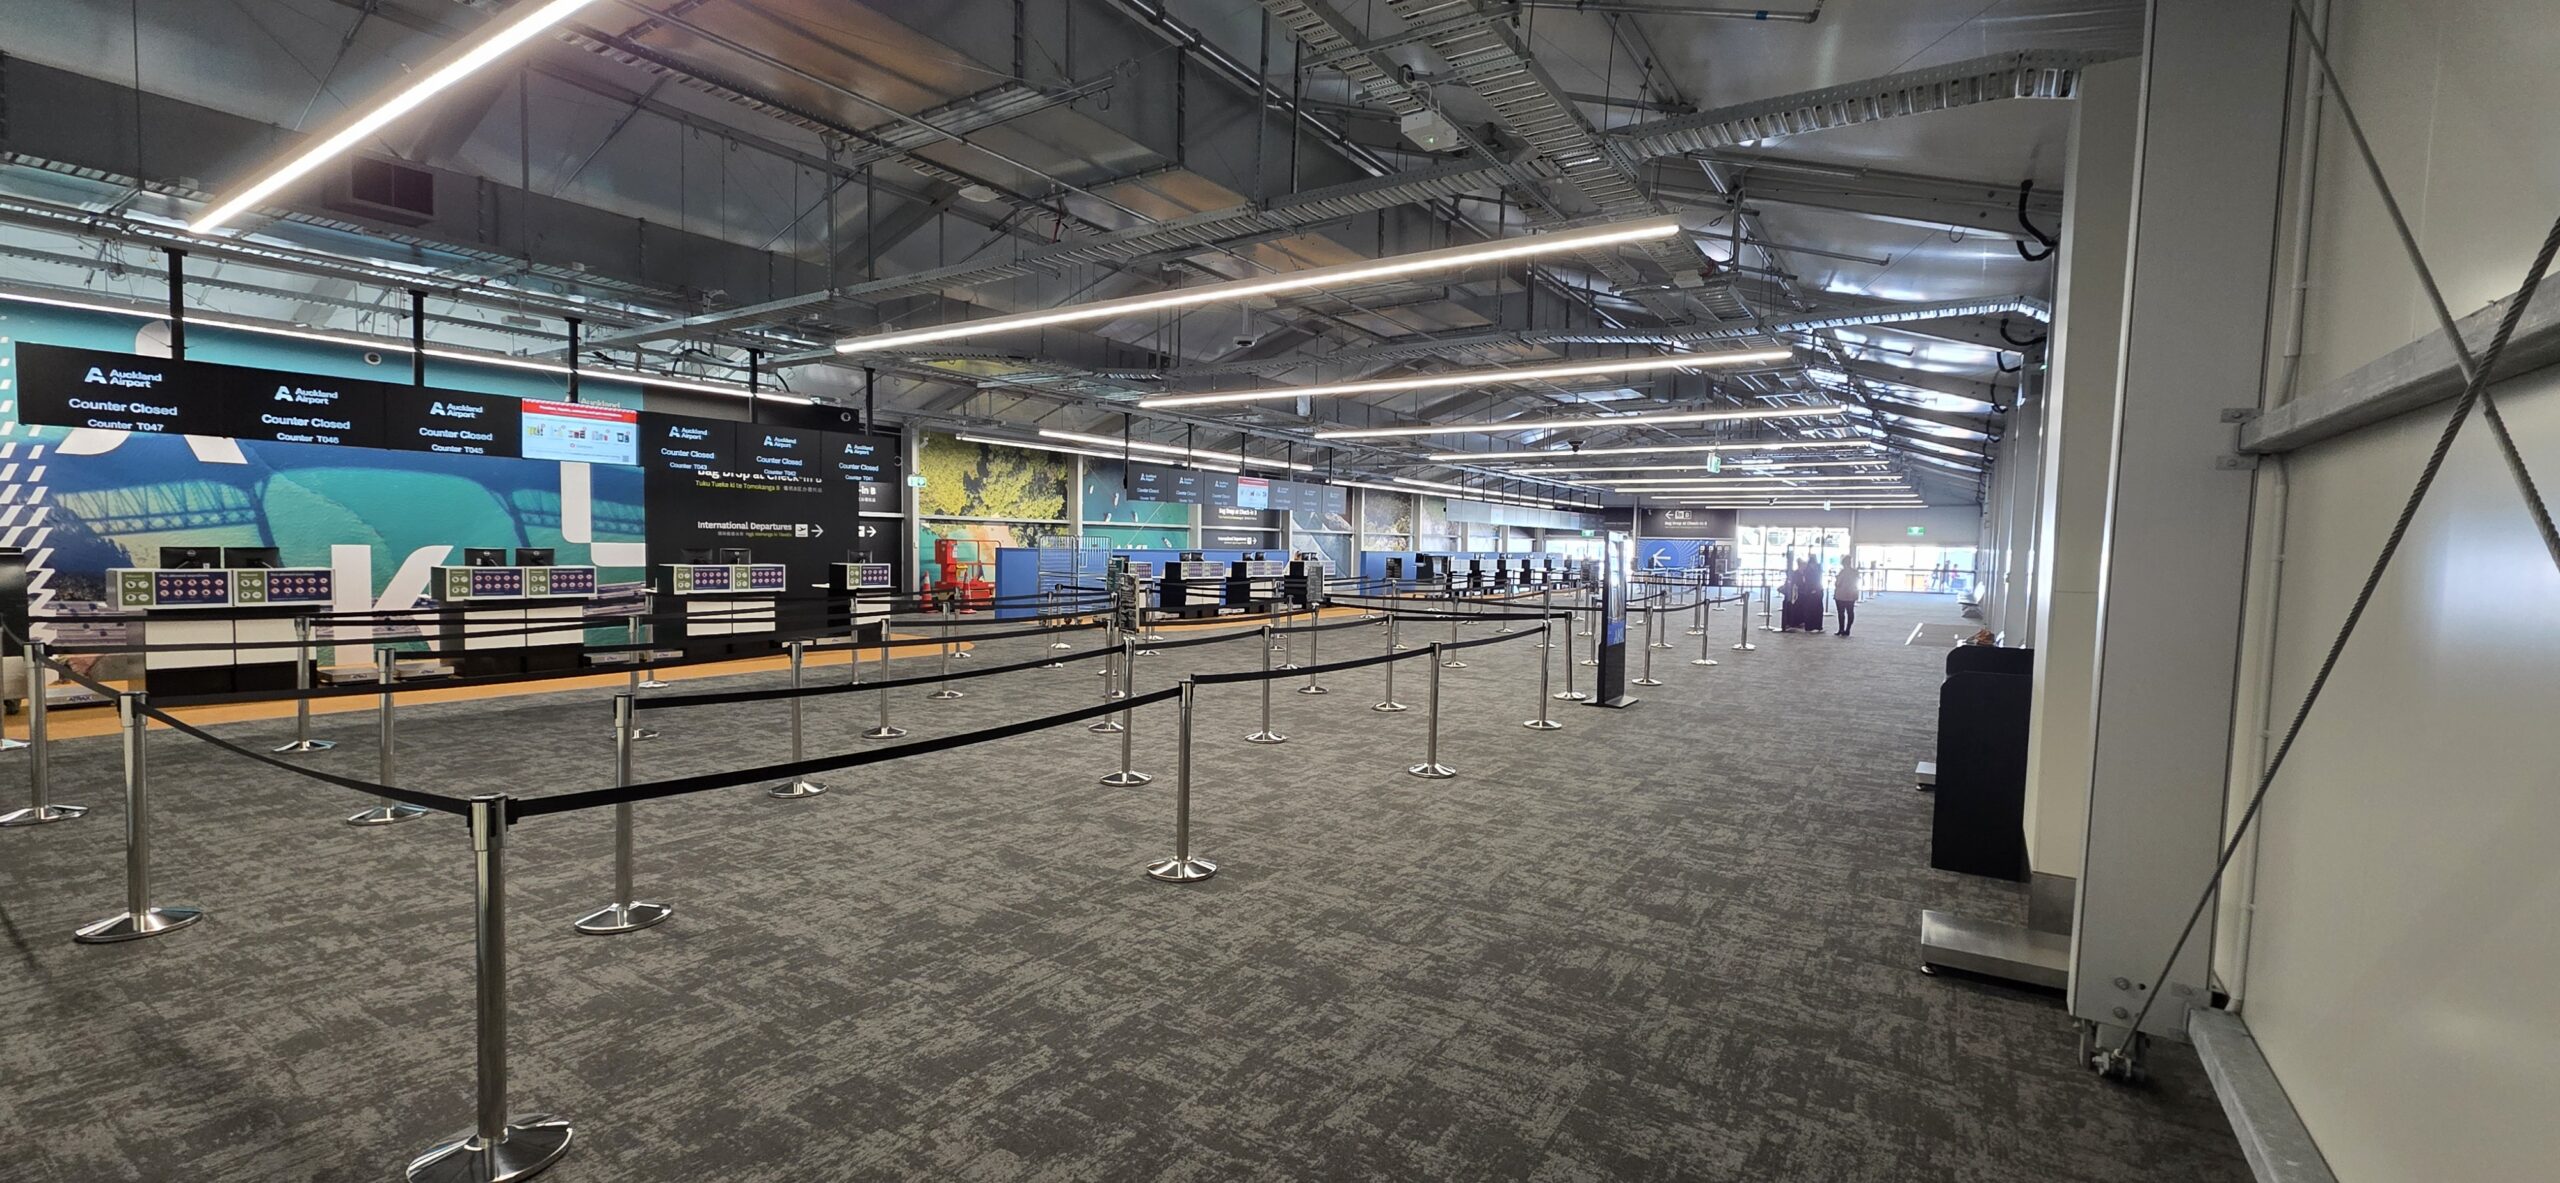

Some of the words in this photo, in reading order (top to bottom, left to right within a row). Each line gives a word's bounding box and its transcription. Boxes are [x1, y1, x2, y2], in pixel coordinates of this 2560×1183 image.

[110, 369, 162, 382] Auckland
[110, 377, 152, 388] Airport
[295, 388, 338, 398] Auckland
[295, 395, 329, 404] Airport
[68, 398, 127, 412] Counter
[130, 403, 178, 416] Closed
[446, 403, 484, 413] Auckland
[446, 410, 476, 418] Airport
[88, 419, 132, 430] Counter
[136, 422, 164, 432] T047
[262, 414, 310, 426] Counter
[311, 418, 350, 429] Closed
[419, 428, 459, 438] Counter
[460, 430, 493, 440] Closed
[681, 428, 708, 436] Auckland
[276, 432, 314, 442] Counter
[316, 435, 340, 444] T046
[431, 444, 462, 452] Counter
[660, 448, 689, 456] Counter
[690, 450, 714, 459] Closed
[698, 521, 748, 530] International
[750, 522, 792, 532] Departures
